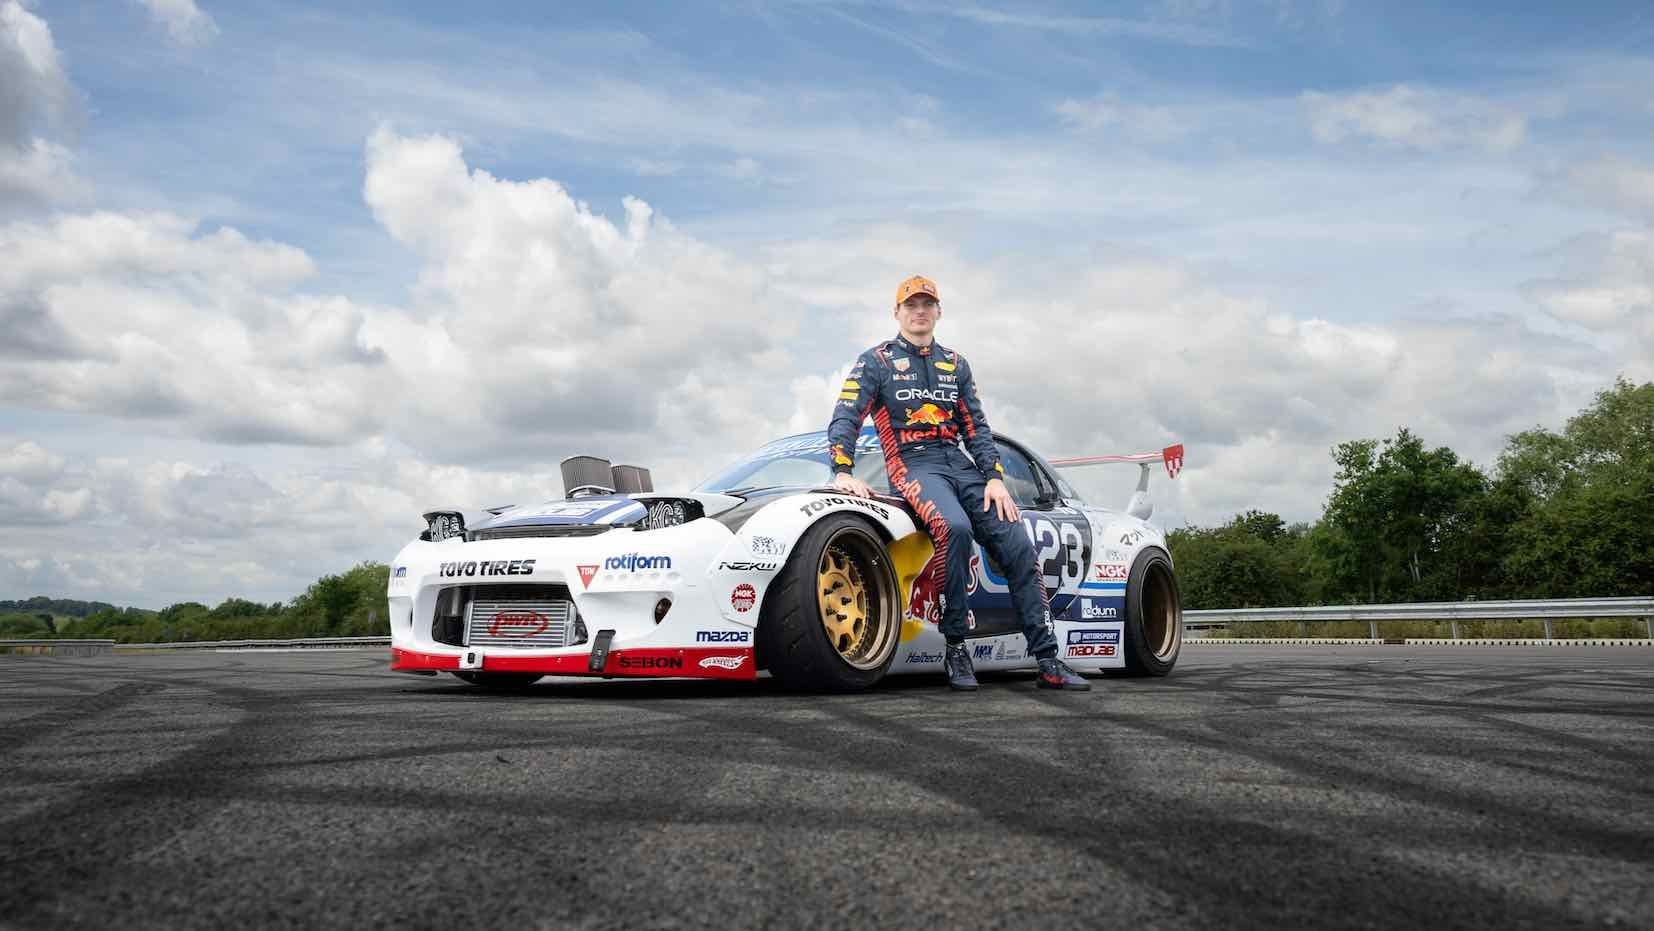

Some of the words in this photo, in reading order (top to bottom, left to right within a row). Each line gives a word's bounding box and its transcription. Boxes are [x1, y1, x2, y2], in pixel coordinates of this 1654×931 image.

[896, 388, 958, 402] ORACLE
[650, 501, 674, 531] KC
[844, 498, 889, 520] TIRES
[479, 560, 536, 576] TIRES
[605, 552, 671, 572] rotiform
[1095, 565, 1127, 578] NGK
[1082, 632, 1118, 640] MOTORSPORT
[905, 652, 944, 664] Haltech
